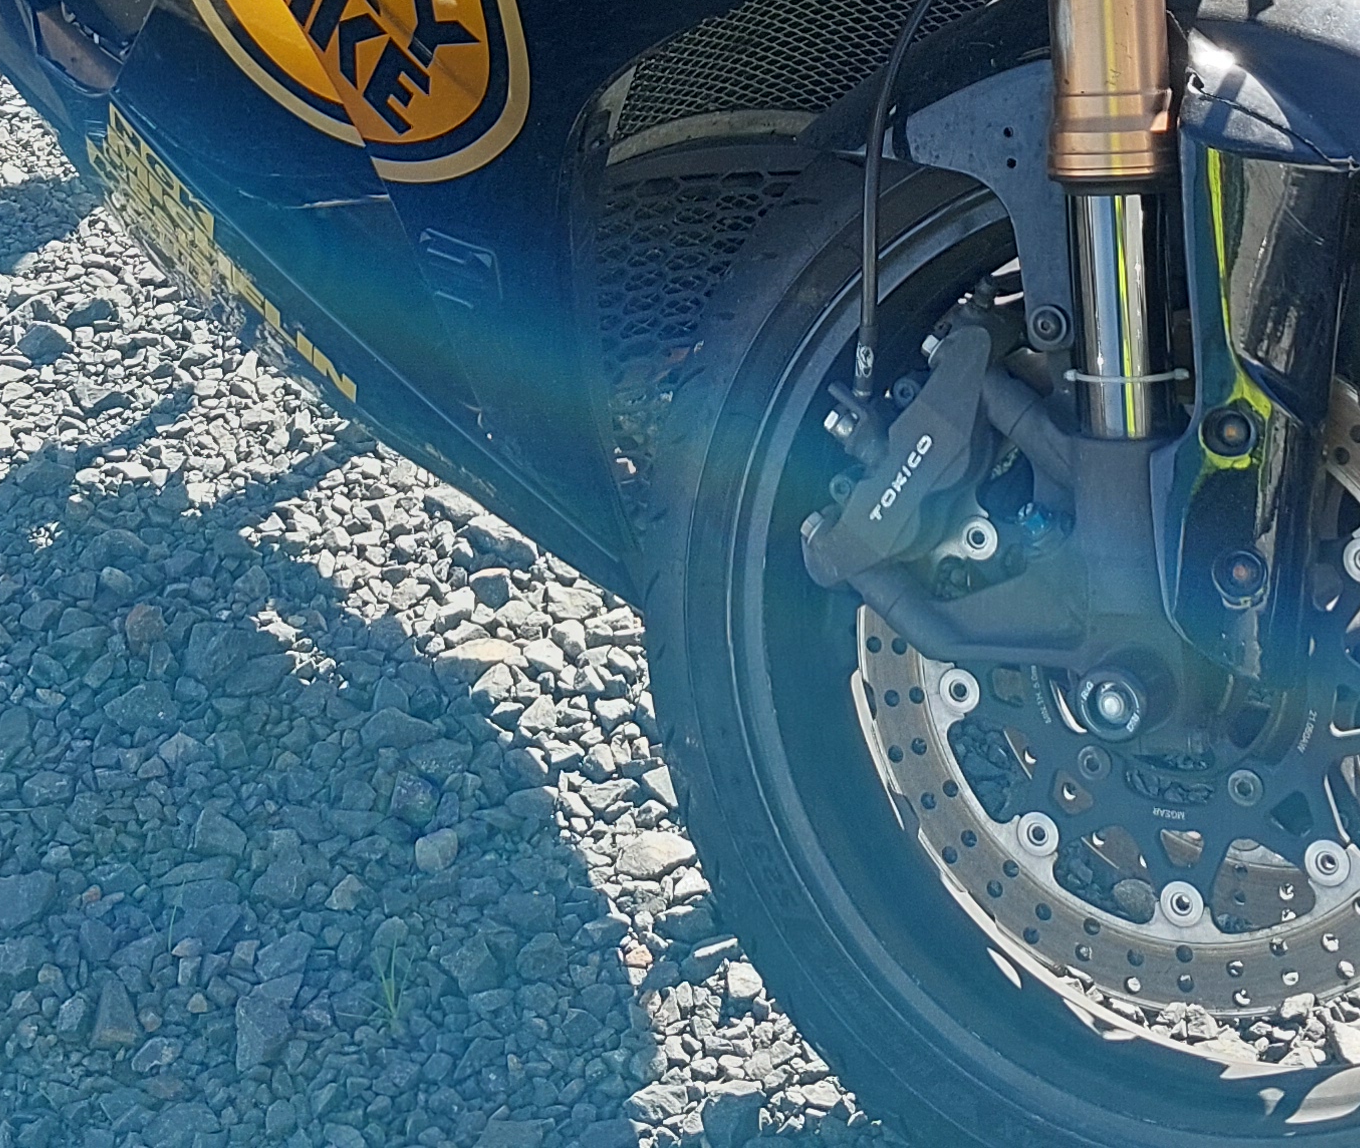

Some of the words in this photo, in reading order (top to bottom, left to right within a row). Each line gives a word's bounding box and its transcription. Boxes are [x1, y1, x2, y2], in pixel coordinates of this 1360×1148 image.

[113, 109, 208, 233] NGK
[106, 122, 357, 403] MICHELIN
[869, 435, 933, 521] TOKICO
